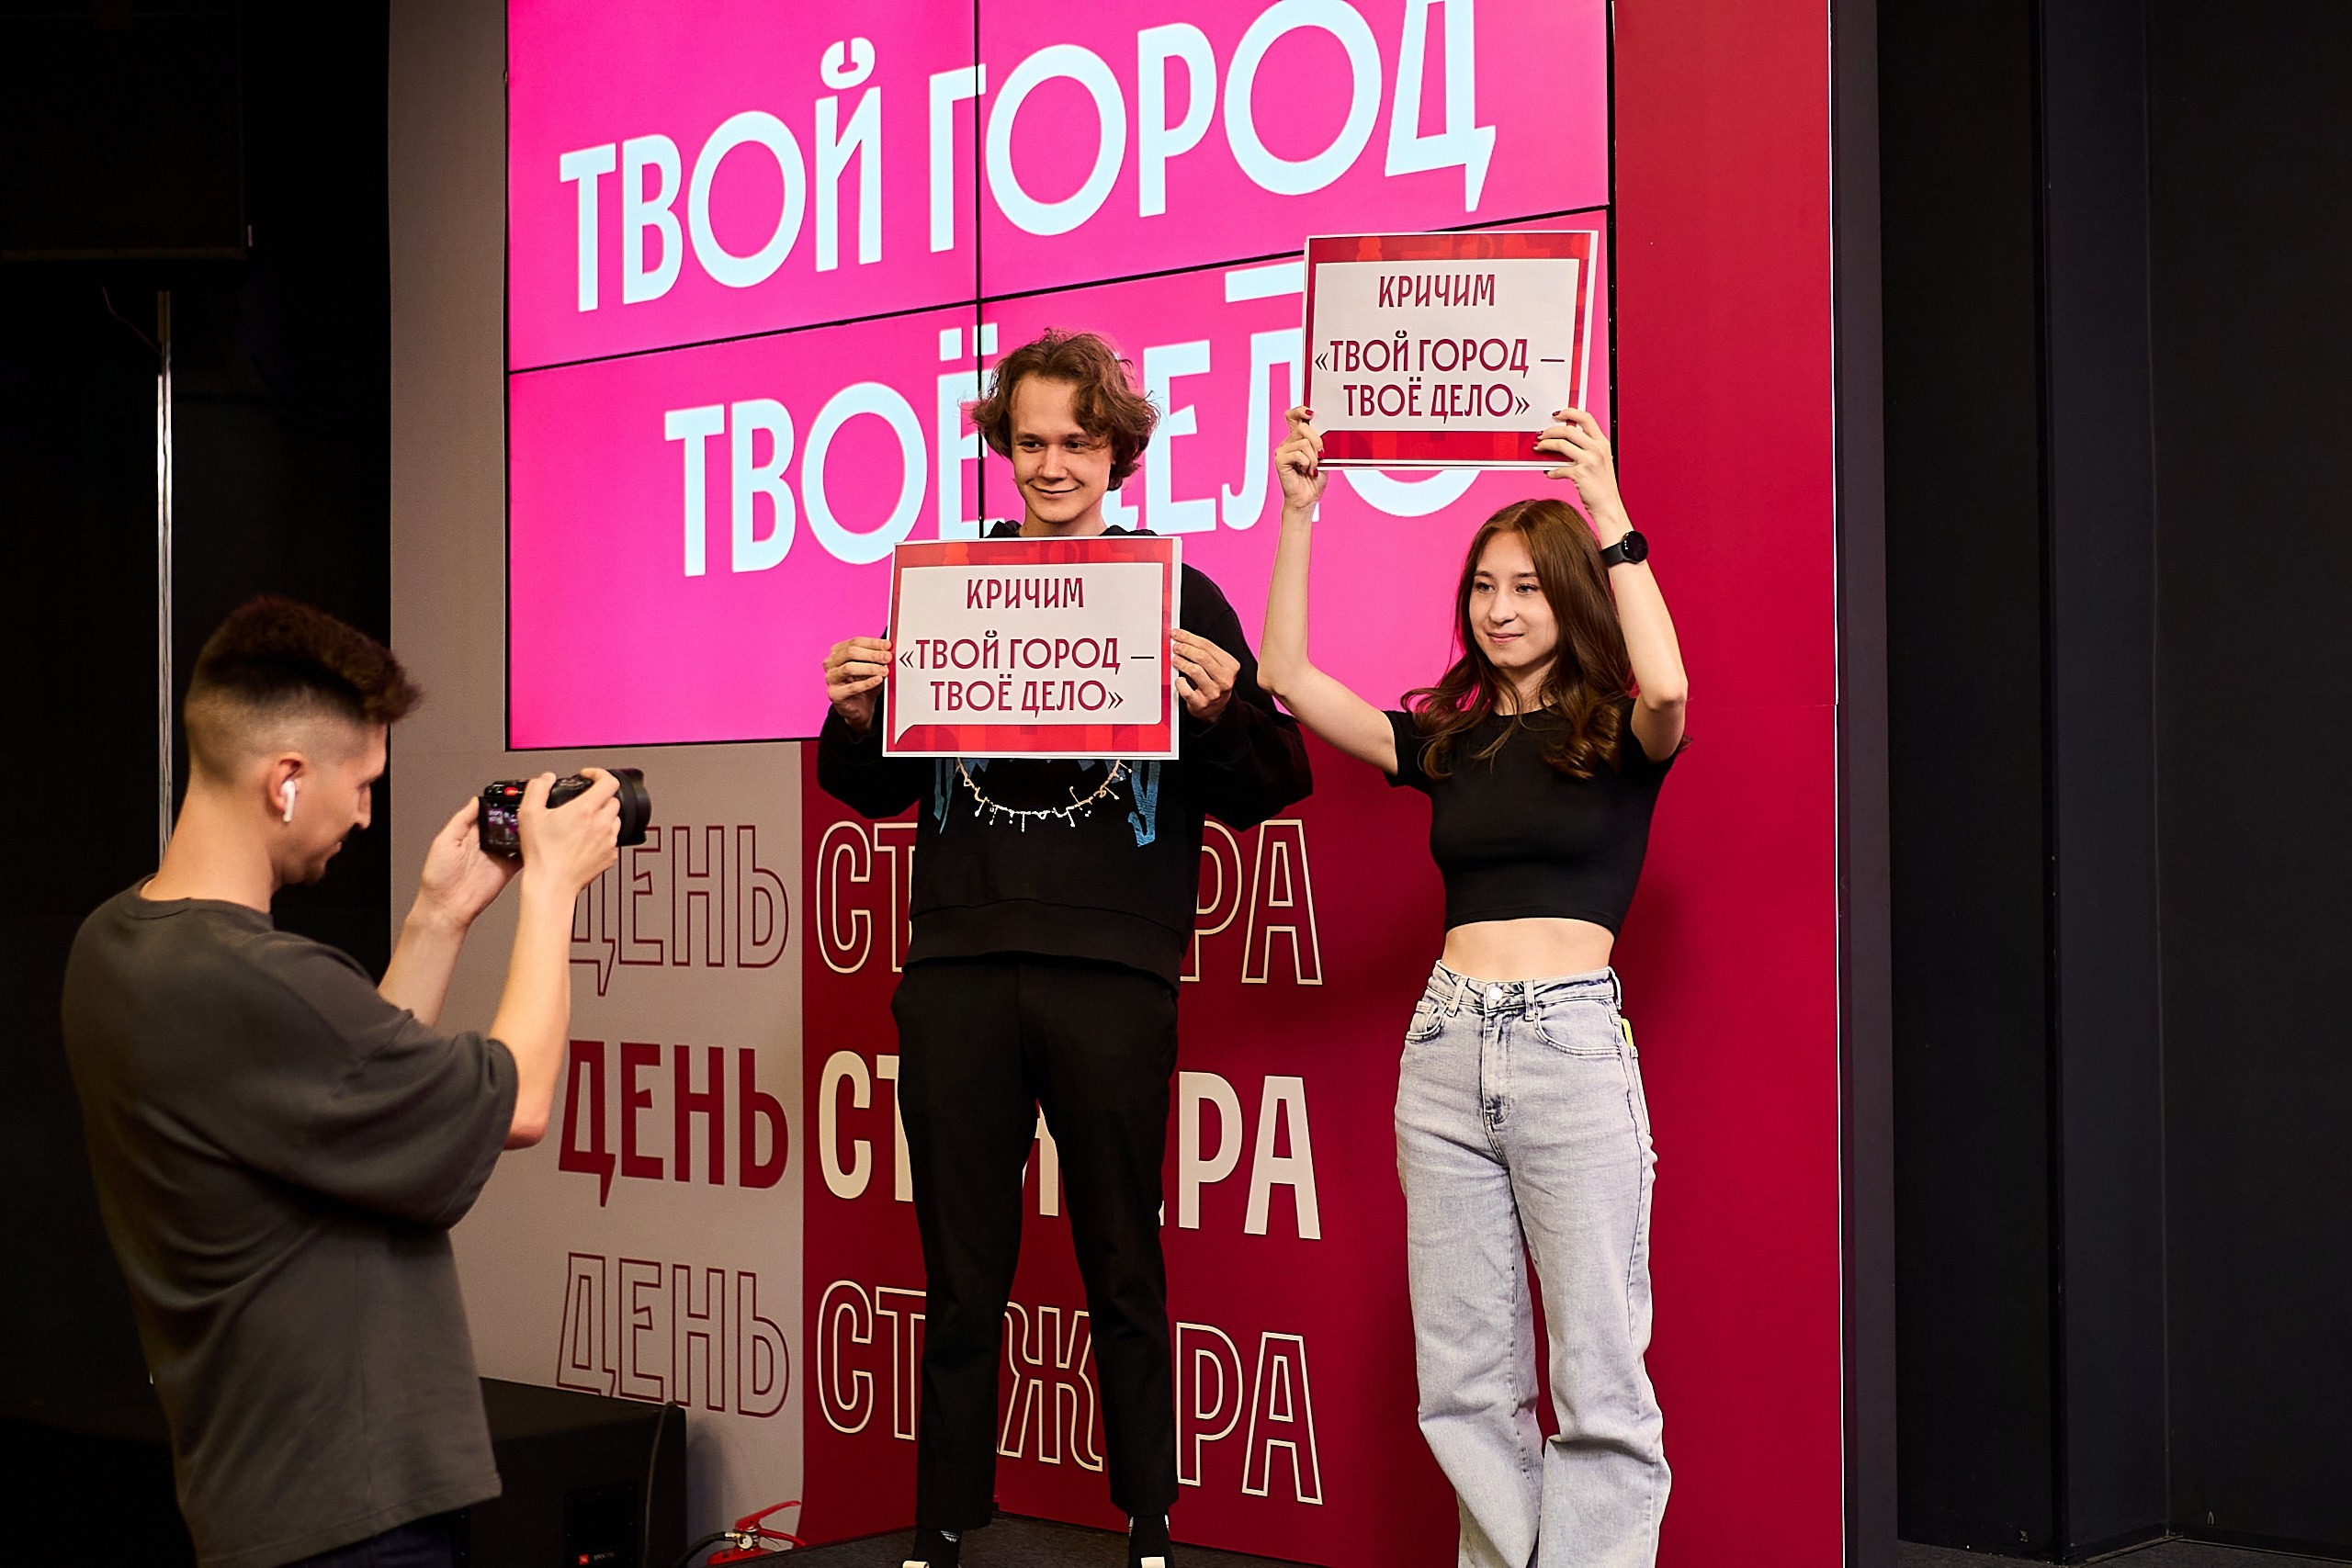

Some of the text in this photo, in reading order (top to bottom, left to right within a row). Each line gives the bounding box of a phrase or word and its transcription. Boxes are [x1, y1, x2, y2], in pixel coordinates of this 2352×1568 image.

[560, 0, 1496, 312] ТВОЙ ГОРОД
[1378, 274, 1495, 308] КРИЧИМ
[1315, 330, 1409, 373] «ТВОЙ
[1419, 338, 1529, 378] ГОРОД
[1343, 376, 1530, 424] ТВОЁ ДЕЛО»
[967, 577, 1084, 609] КРИЧИМ
[899, 629, 999, 670] «ТВОЙ
[1010, 637, 1121, 675] ГОРОД
[930, 673, 1124, 718] ТВОЁ ДЕЛО»
[558, 1039, 789, 1208] ДЕНЬ
[556, 1252, 790, 1418] ДЕНЬ
